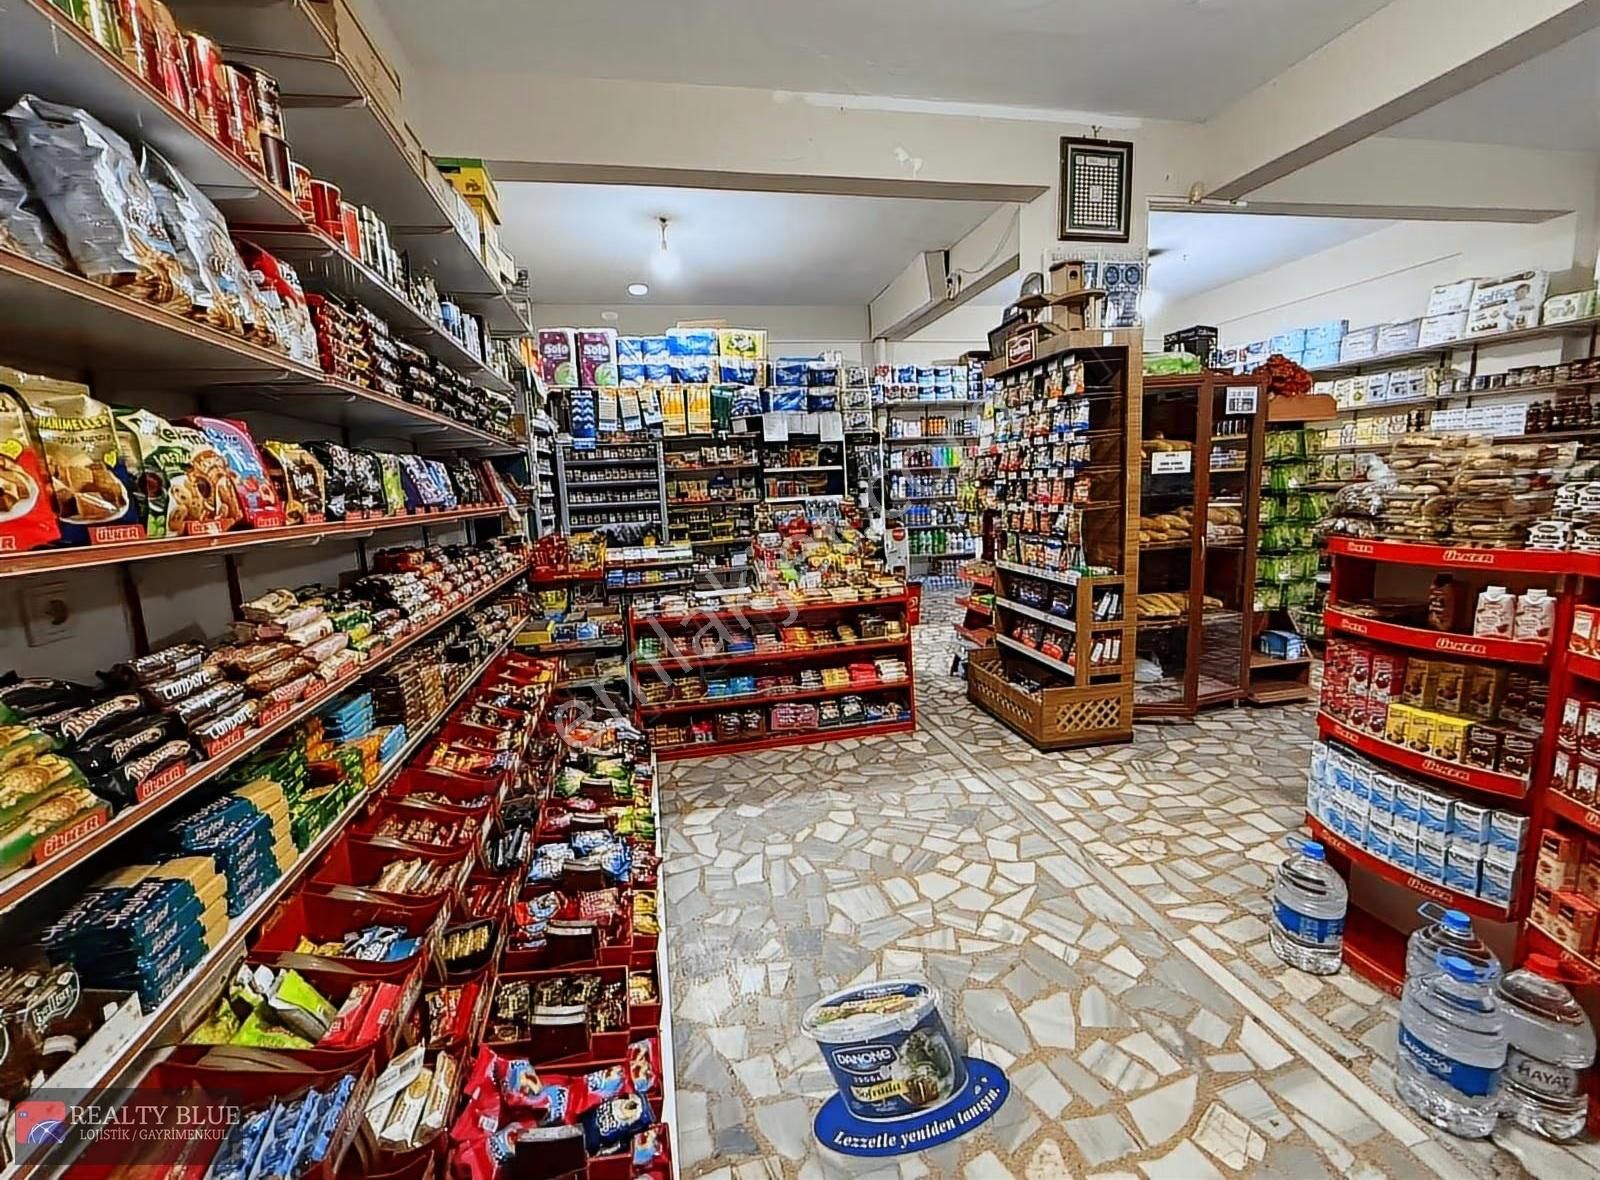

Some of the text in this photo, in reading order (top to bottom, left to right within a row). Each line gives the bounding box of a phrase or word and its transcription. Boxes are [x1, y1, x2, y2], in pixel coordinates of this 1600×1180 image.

[97, 527, 139, 542] ÜLKER
[1518, 1061, 1569, 1089] HAYAT
[833, 1131, 897, 1148] Lezzetle
[900, 1118, 956, 1148] yeniden
